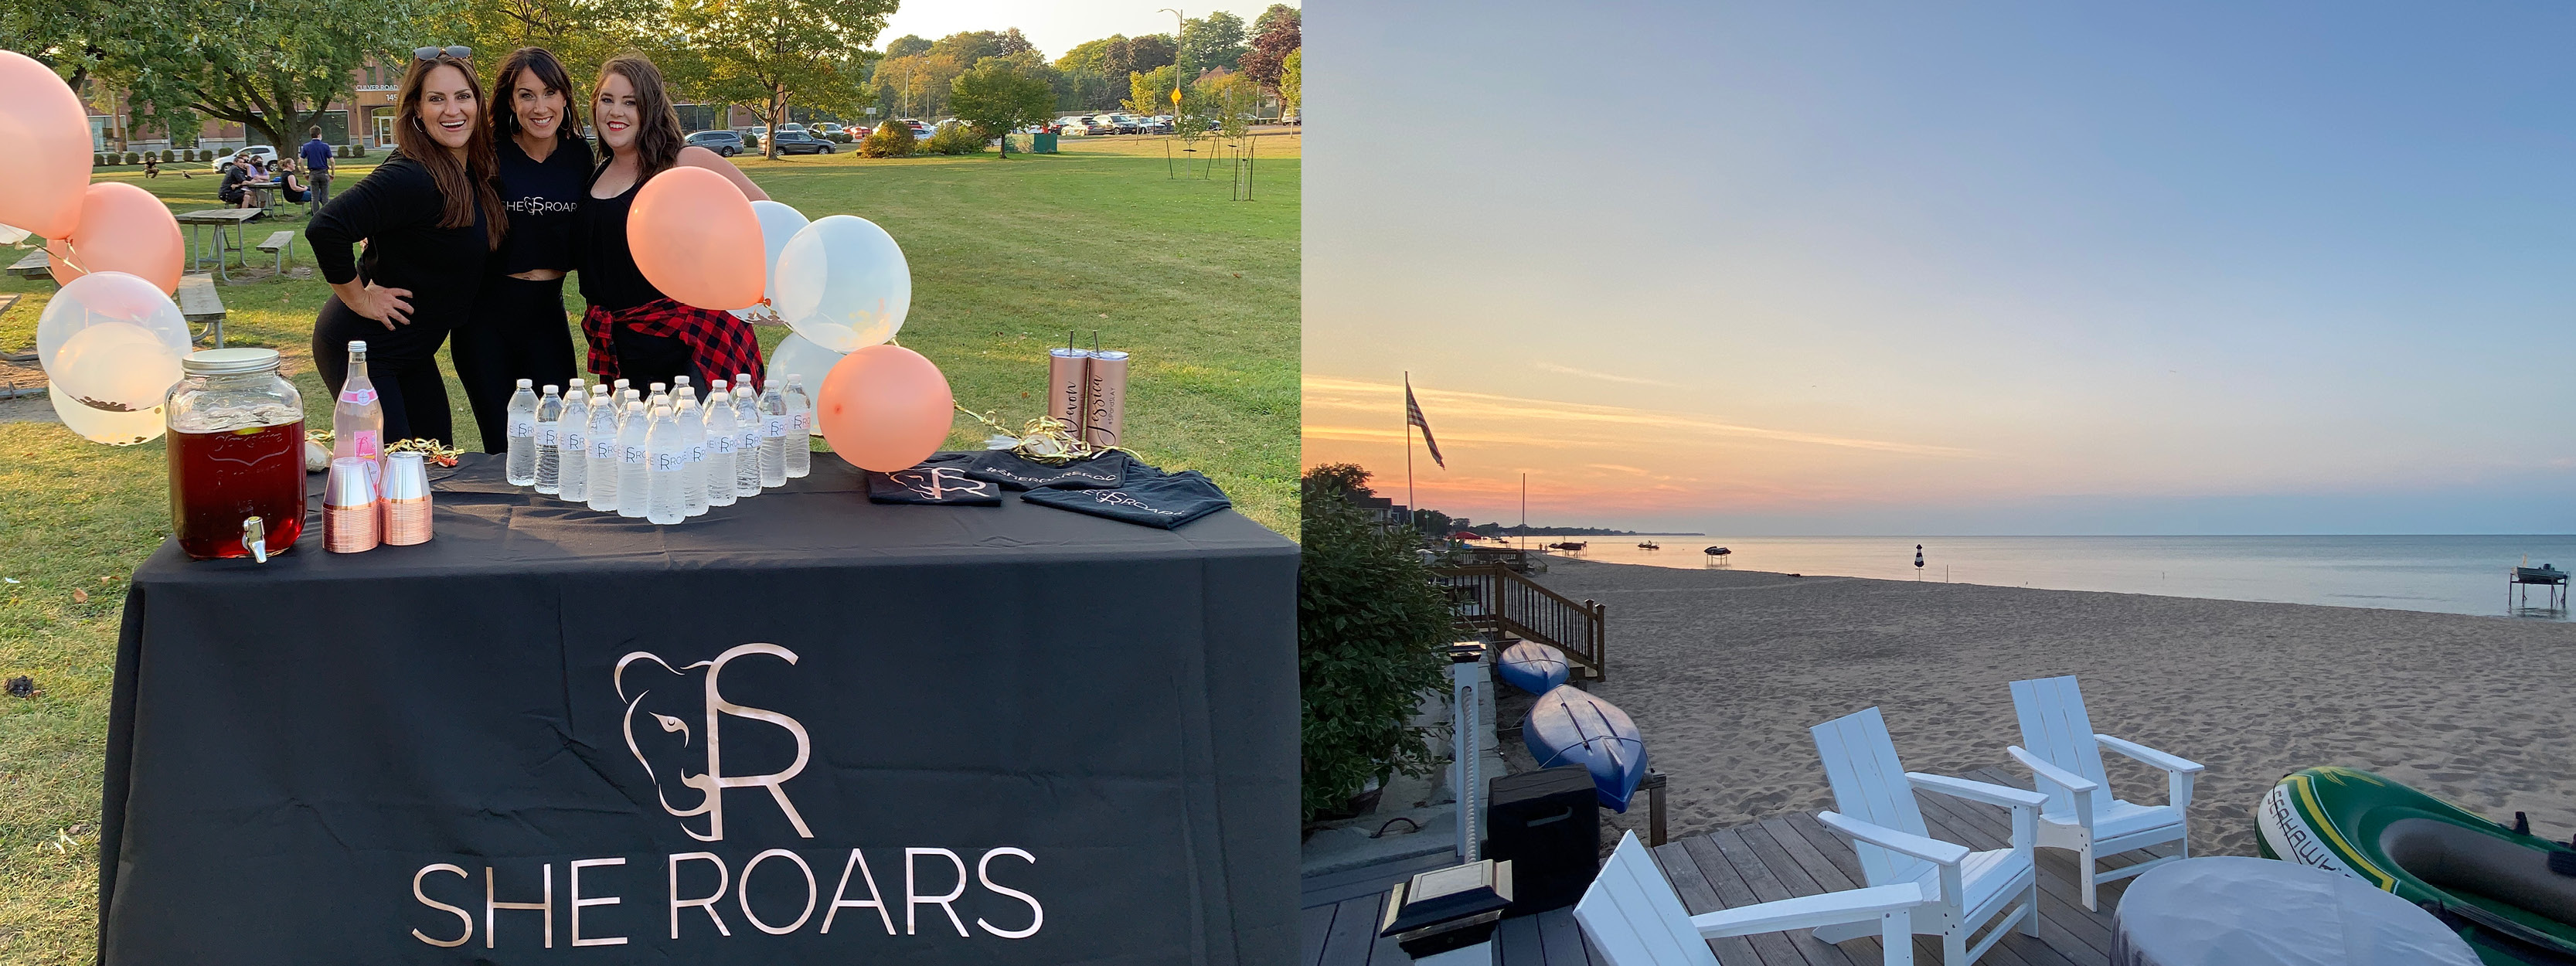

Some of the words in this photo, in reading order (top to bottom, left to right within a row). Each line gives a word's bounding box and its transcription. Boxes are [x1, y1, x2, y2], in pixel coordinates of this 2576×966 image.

[1057, 381, 1081, 438] Devon
[1087, 374, 1117, 447] Jessica
[412, 856, 628, 949] SHE
[669, 847, 1044, 939] ROARS
